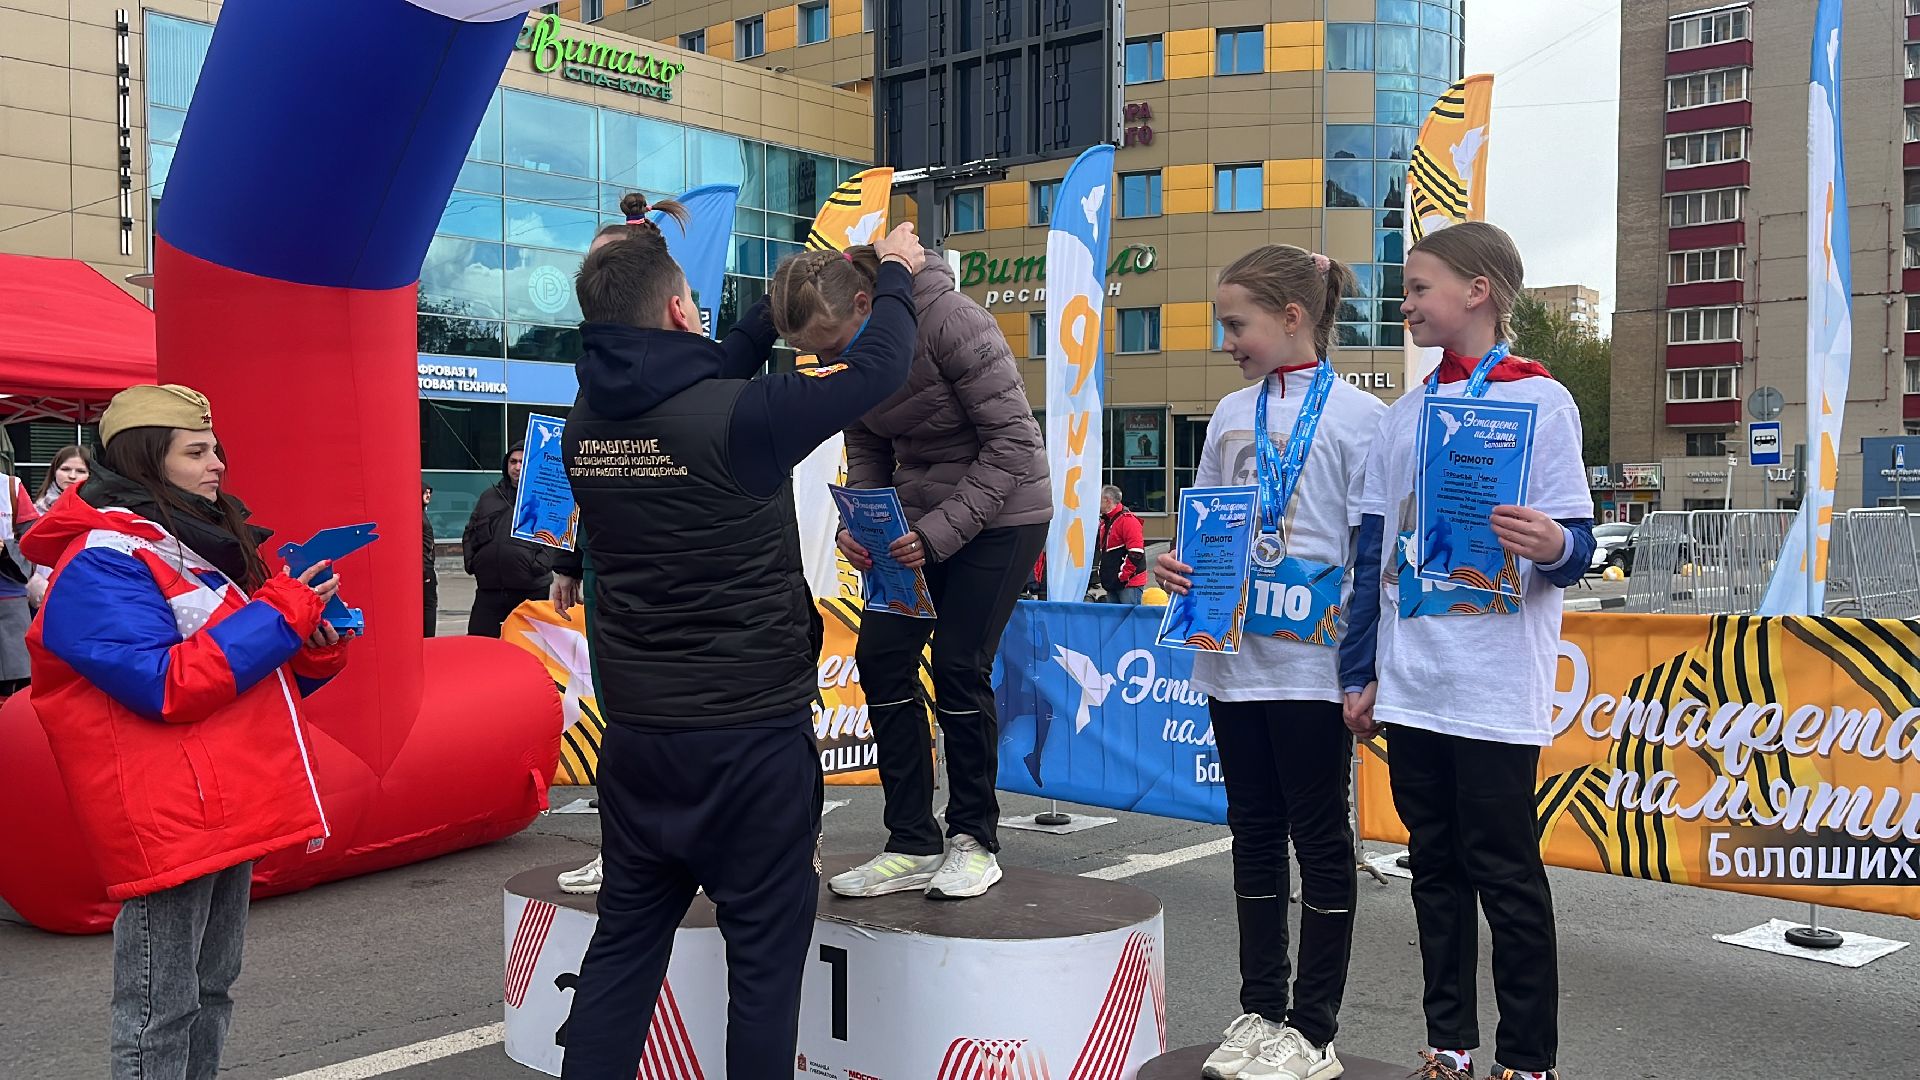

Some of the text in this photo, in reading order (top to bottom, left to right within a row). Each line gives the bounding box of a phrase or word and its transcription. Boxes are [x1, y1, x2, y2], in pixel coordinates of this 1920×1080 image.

[564, 65, 673, 101] СПА-КЛУБ
[985, 282, 1122, 309] рестн
[418, 364, 478, 378] ФРОВАЯ И
[457, 380, 508, 394] ТЕХНИКА
[1339, 372, 1396, 388] OTEL
[578, 439, 660, 454] УПРАВЛЕНИЕ
[583, 455, 631, 466] ФИЗИЧЕСКОЙ
[632, 456, 674, 466] КУЛЬТУРЕ,
[1449, 450, 1494, 466] Грамота
[596, 468, 622, 477] РАБОТЕ
[624, 468, 629, 477] С
[630, 465, 688, 478] МОЛОДЕЖЬЮ
[1201, 533, 1233, 547] Грамота
[1254, 579, 1312, 622] 110
[1708, 832, 1920, 879] Балаших
[819, 943, 848, 1042] 1
